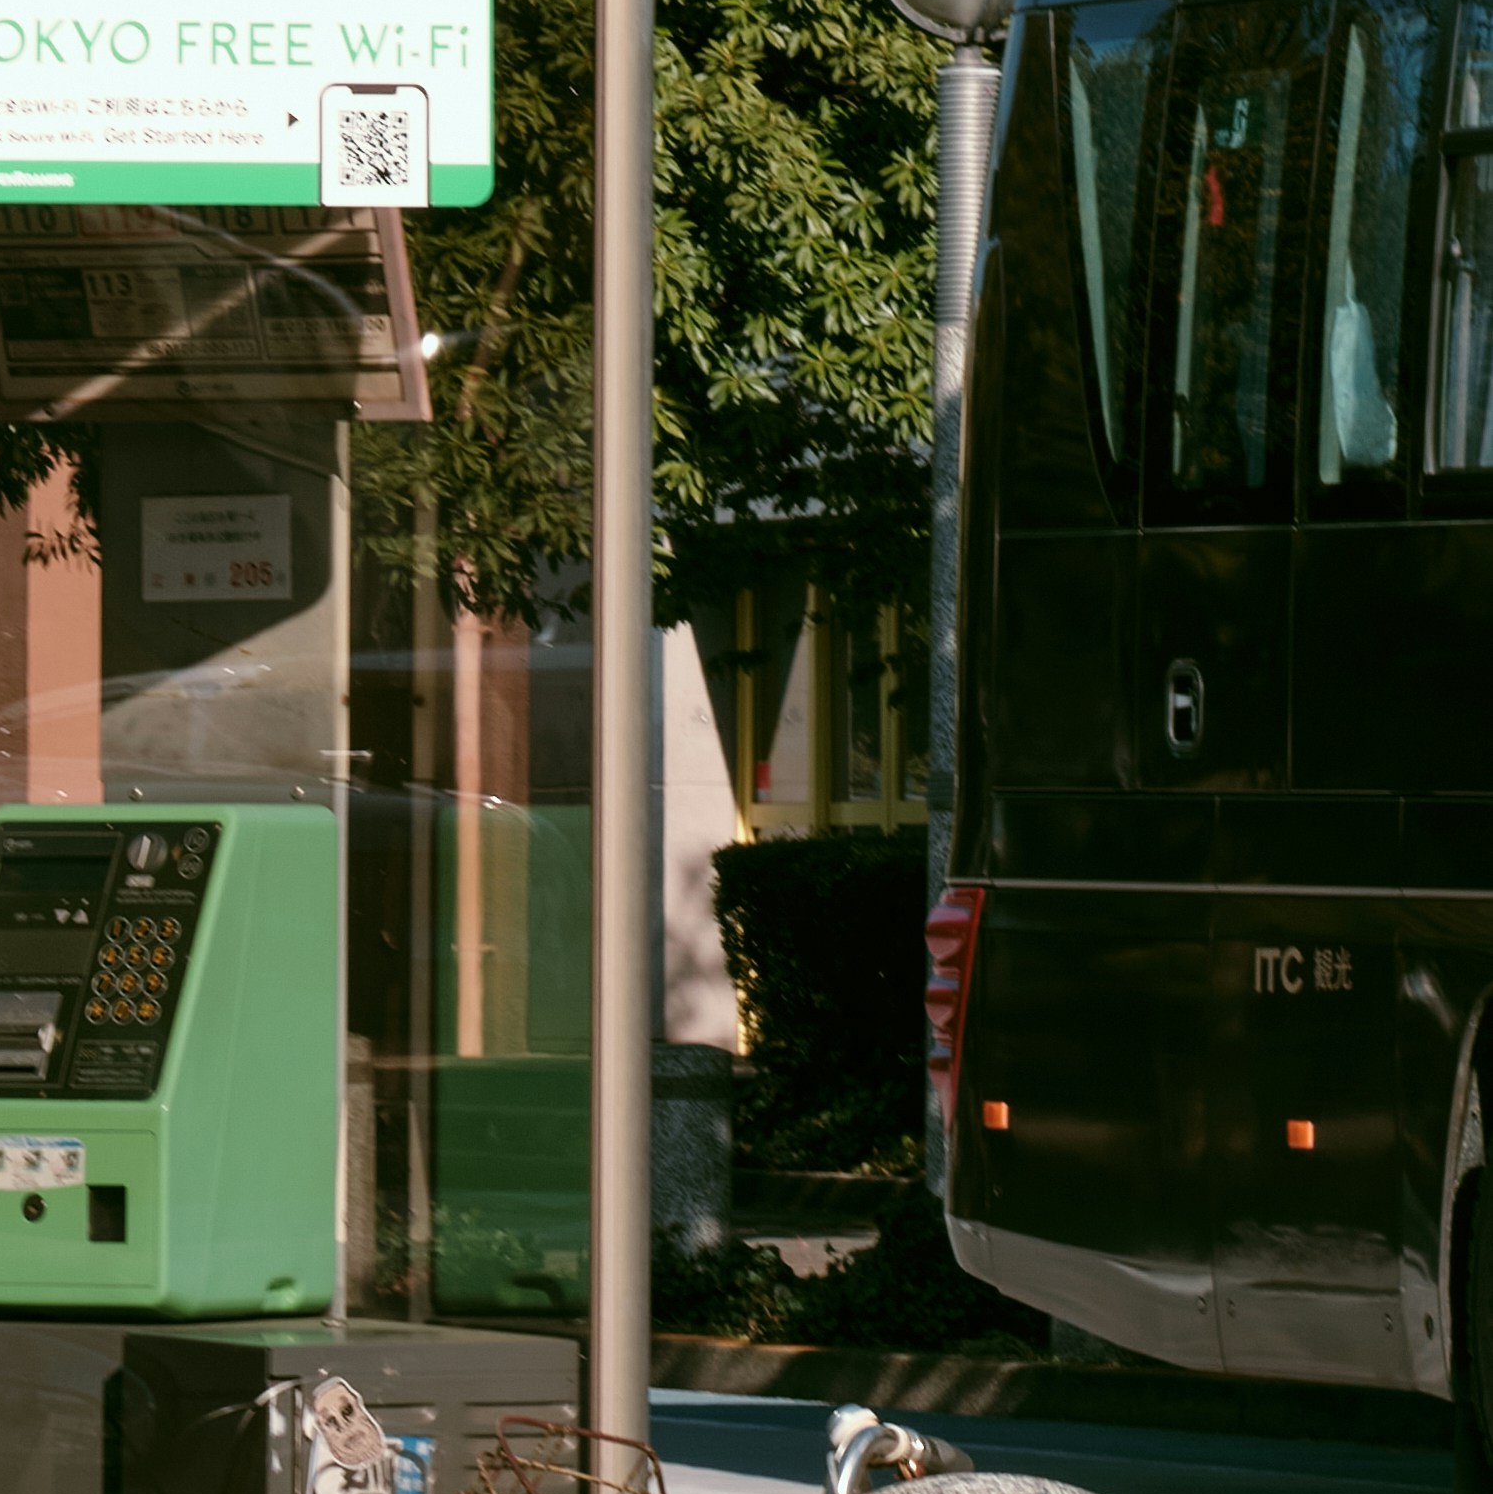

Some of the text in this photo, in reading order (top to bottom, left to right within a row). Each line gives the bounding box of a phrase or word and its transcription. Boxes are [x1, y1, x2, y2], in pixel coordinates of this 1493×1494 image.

[177, 21, 314, 66] FREE
[339, 22, 470, 68] Wi-Fi
[86, 273, 132, 296] 113
[229, 561, 273, 588] 205
[1254, 945, 1305, 995] ITC
